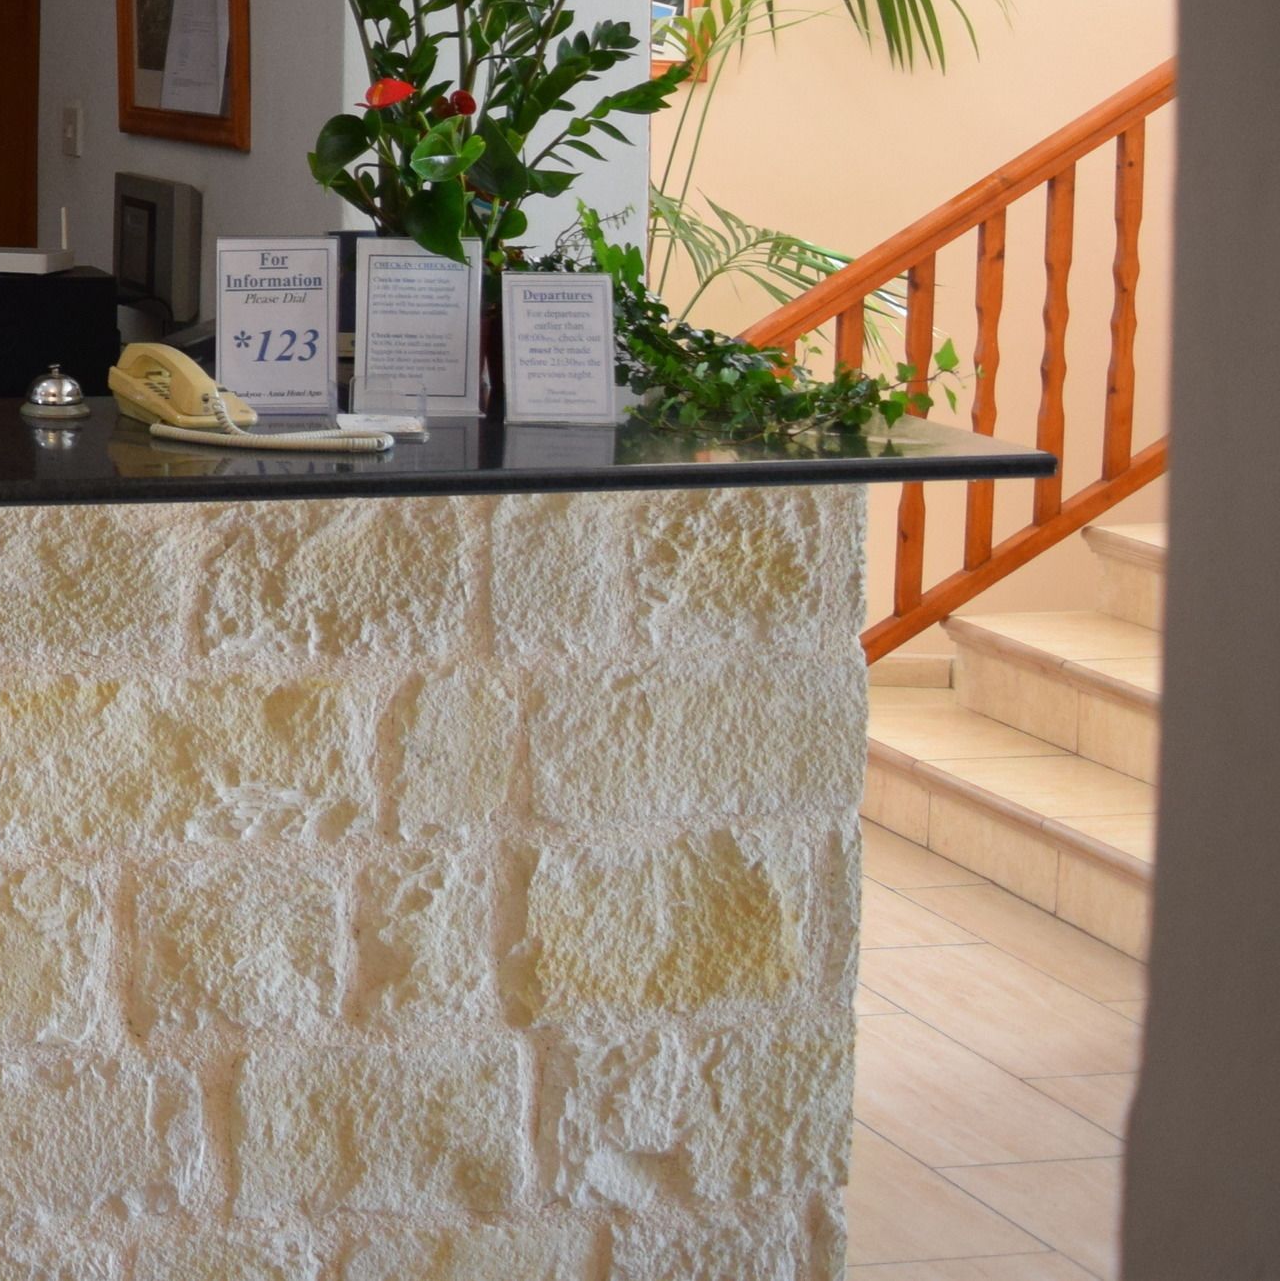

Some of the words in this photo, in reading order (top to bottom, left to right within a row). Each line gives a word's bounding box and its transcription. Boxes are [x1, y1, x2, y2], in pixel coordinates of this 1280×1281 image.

[260, 252, 288, 267] For
[225, 273, 322, 288] Information
[244, 292, 279, 304] Please
[282, 291, 307, 304] Dial
[523, 289, 593, 302] Departures
[544, 309, 591, 319] departures
[519, 358, 547, 367] before
